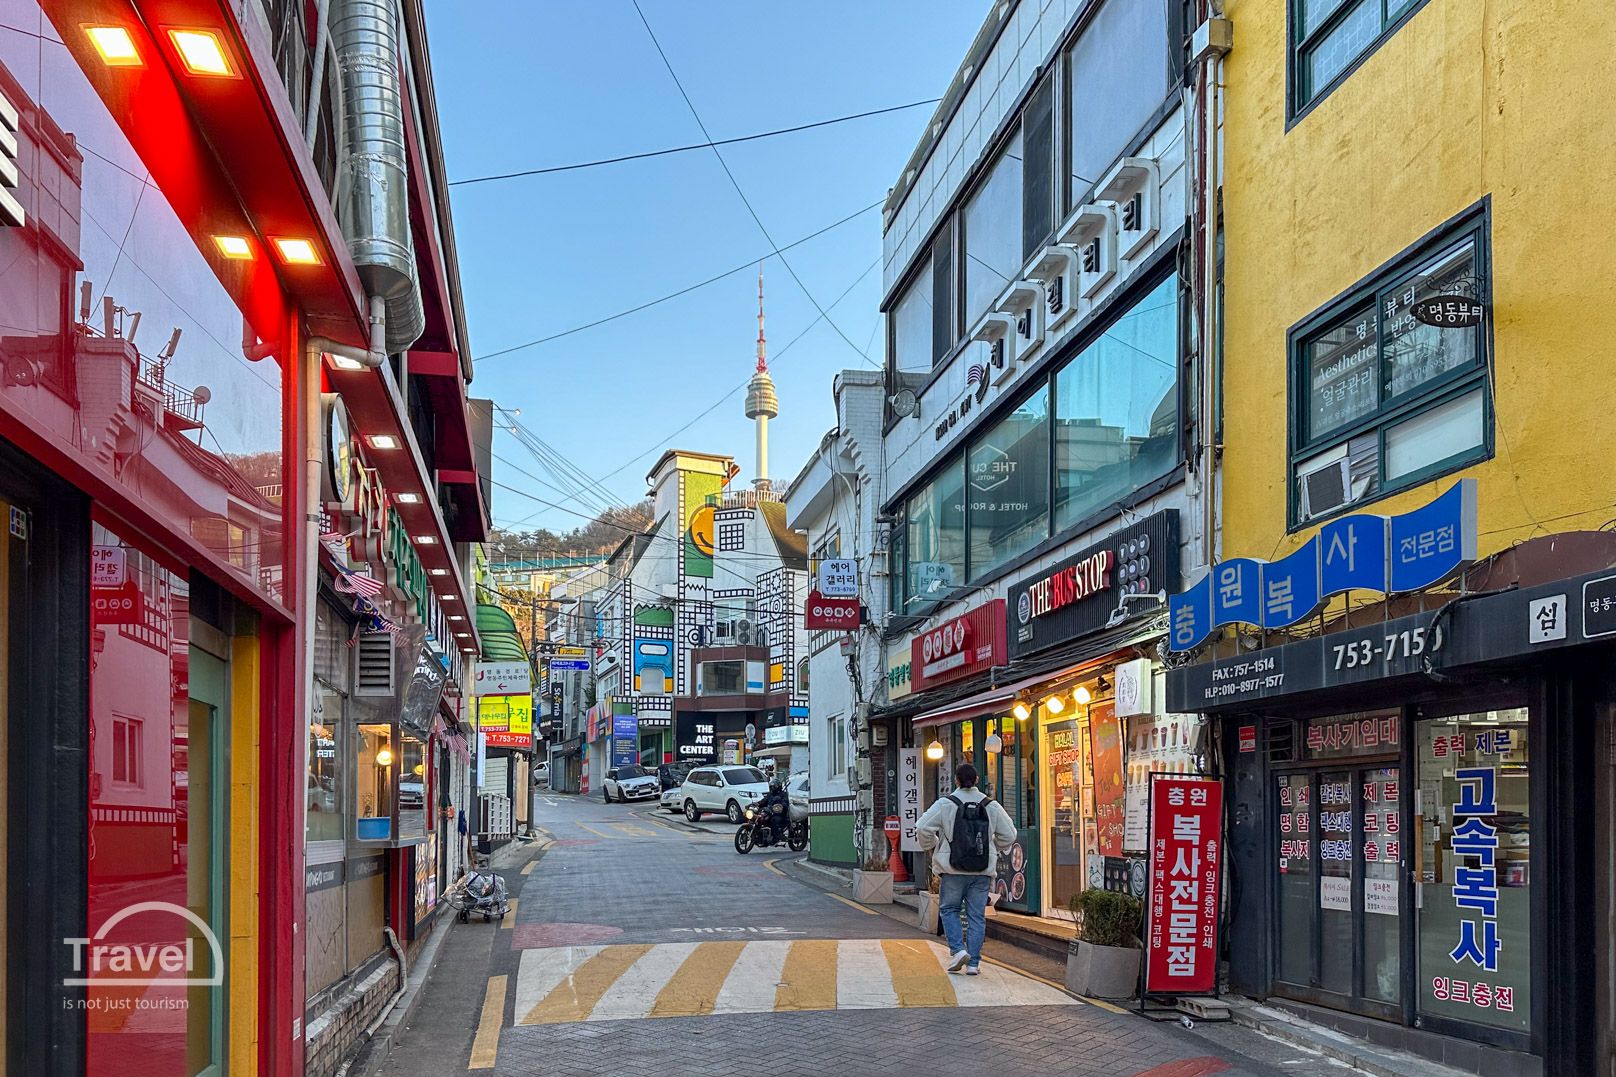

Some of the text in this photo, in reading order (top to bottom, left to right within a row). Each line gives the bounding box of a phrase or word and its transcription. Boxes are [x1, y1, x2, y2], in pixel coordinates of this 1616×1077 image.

[1429, 302, 1484, 324] 명동뷰티
[1318, 341, 1378, 381] Aesthetics
[1323, 366, 1372, 408] 얼굴관리
[1400, 524, 1455, 563] 전문점
[831, 562, 850, 573] 헤어
[826, 574, 855, 586] 갤러리
[1029, 550, 1107, 618] THE BUS STOP
[492, 734, 530, 743] T.753-7271
[695, 724, 714, 734] THE
[695, 735, 714, 744] ART
[1307, 716, 1399, 751] 복사기임대
[680, 745, 714, 755] CENTER
[1054, 731, 1075, 749] HALAL
[1432, 730, 1512, 757] 출력 제본
[1049, 748, 1079, 767] GIFT SHOP
[904, 755, 918, 843] 헤어갤러리
[1168, 787, 1208, 807] 충원
[1363, 781, 1399, 803] 제본
[1280, 812, 1310, 833] 명함
[1363, 812, 1399, 833] 코팅
[1280, 839, 1310, 860] 복사지
[1363, 841, 1399, 862] 출력
[1449, 767, 1502, 972] 고속복사
[1166, 813, 1201, 977] 복사전문점
[1432, 976, 1514, 1012] 잉크충전
